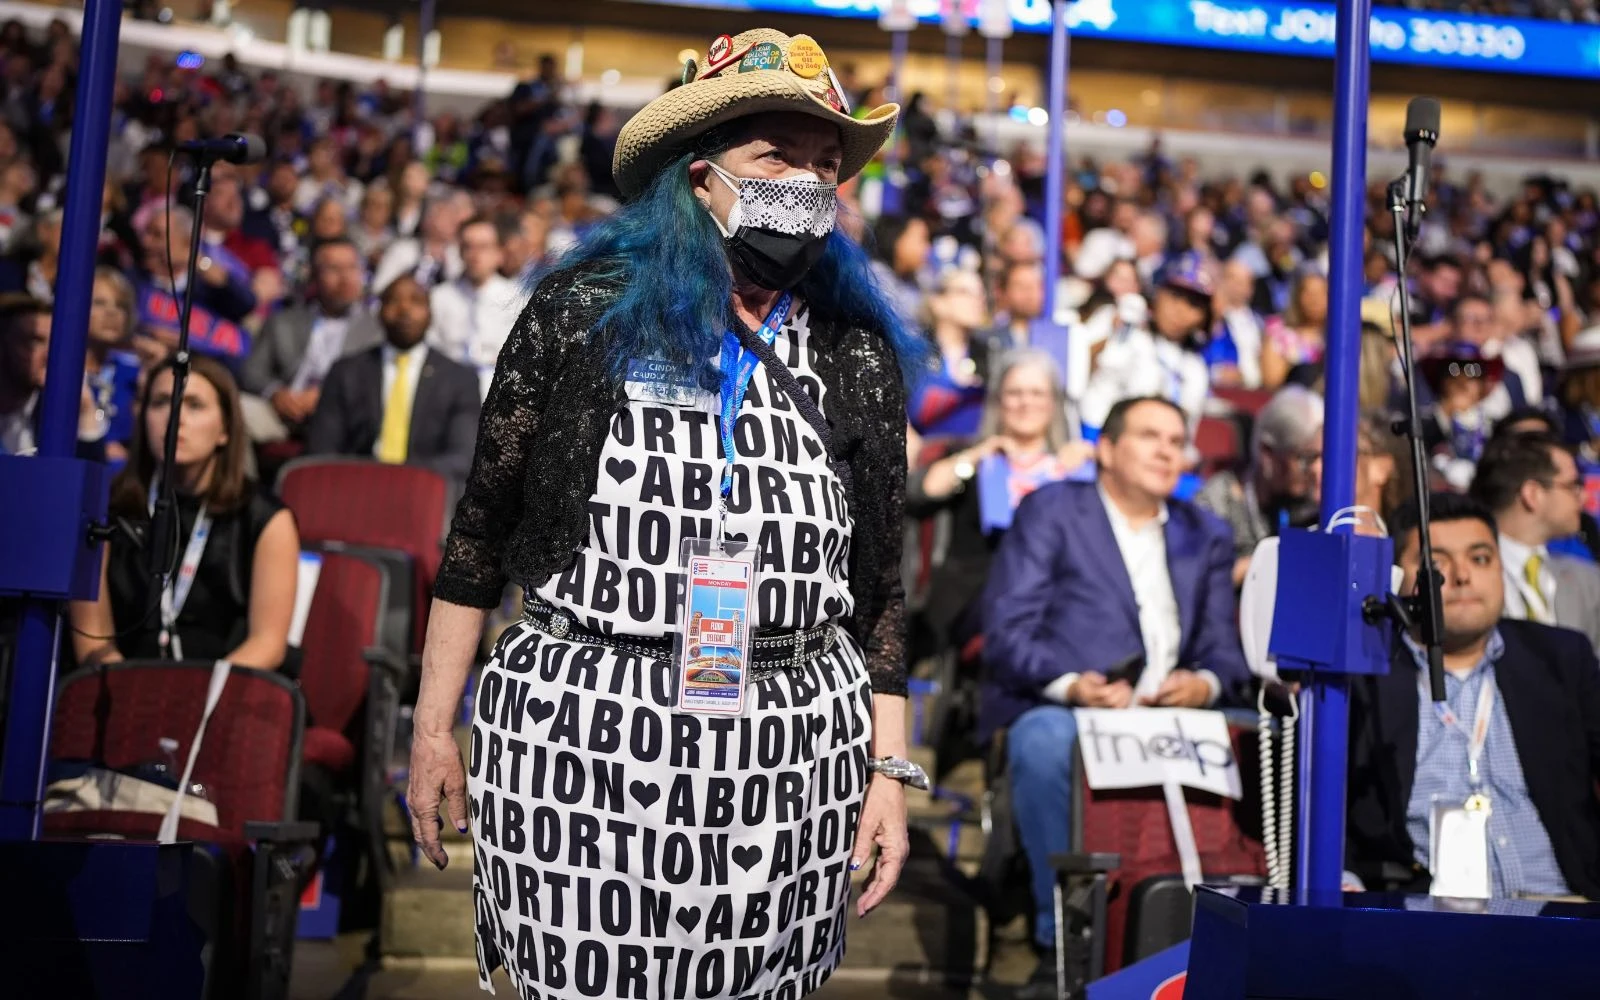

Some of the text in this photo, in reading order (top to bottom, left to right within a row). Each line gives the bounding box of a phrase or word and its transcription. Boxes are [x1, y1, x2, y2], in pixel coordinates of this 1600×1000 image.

[743, 56, 778, 66] GET OUT
[648, 363, 678, 372] CINDY
[469, 723, 625, 814] ORTION
[547, 691, 815, 771] ABORTION
[480, 790, 729, 886] ABORTION
[517, 923, 765, 999] ABORTION
